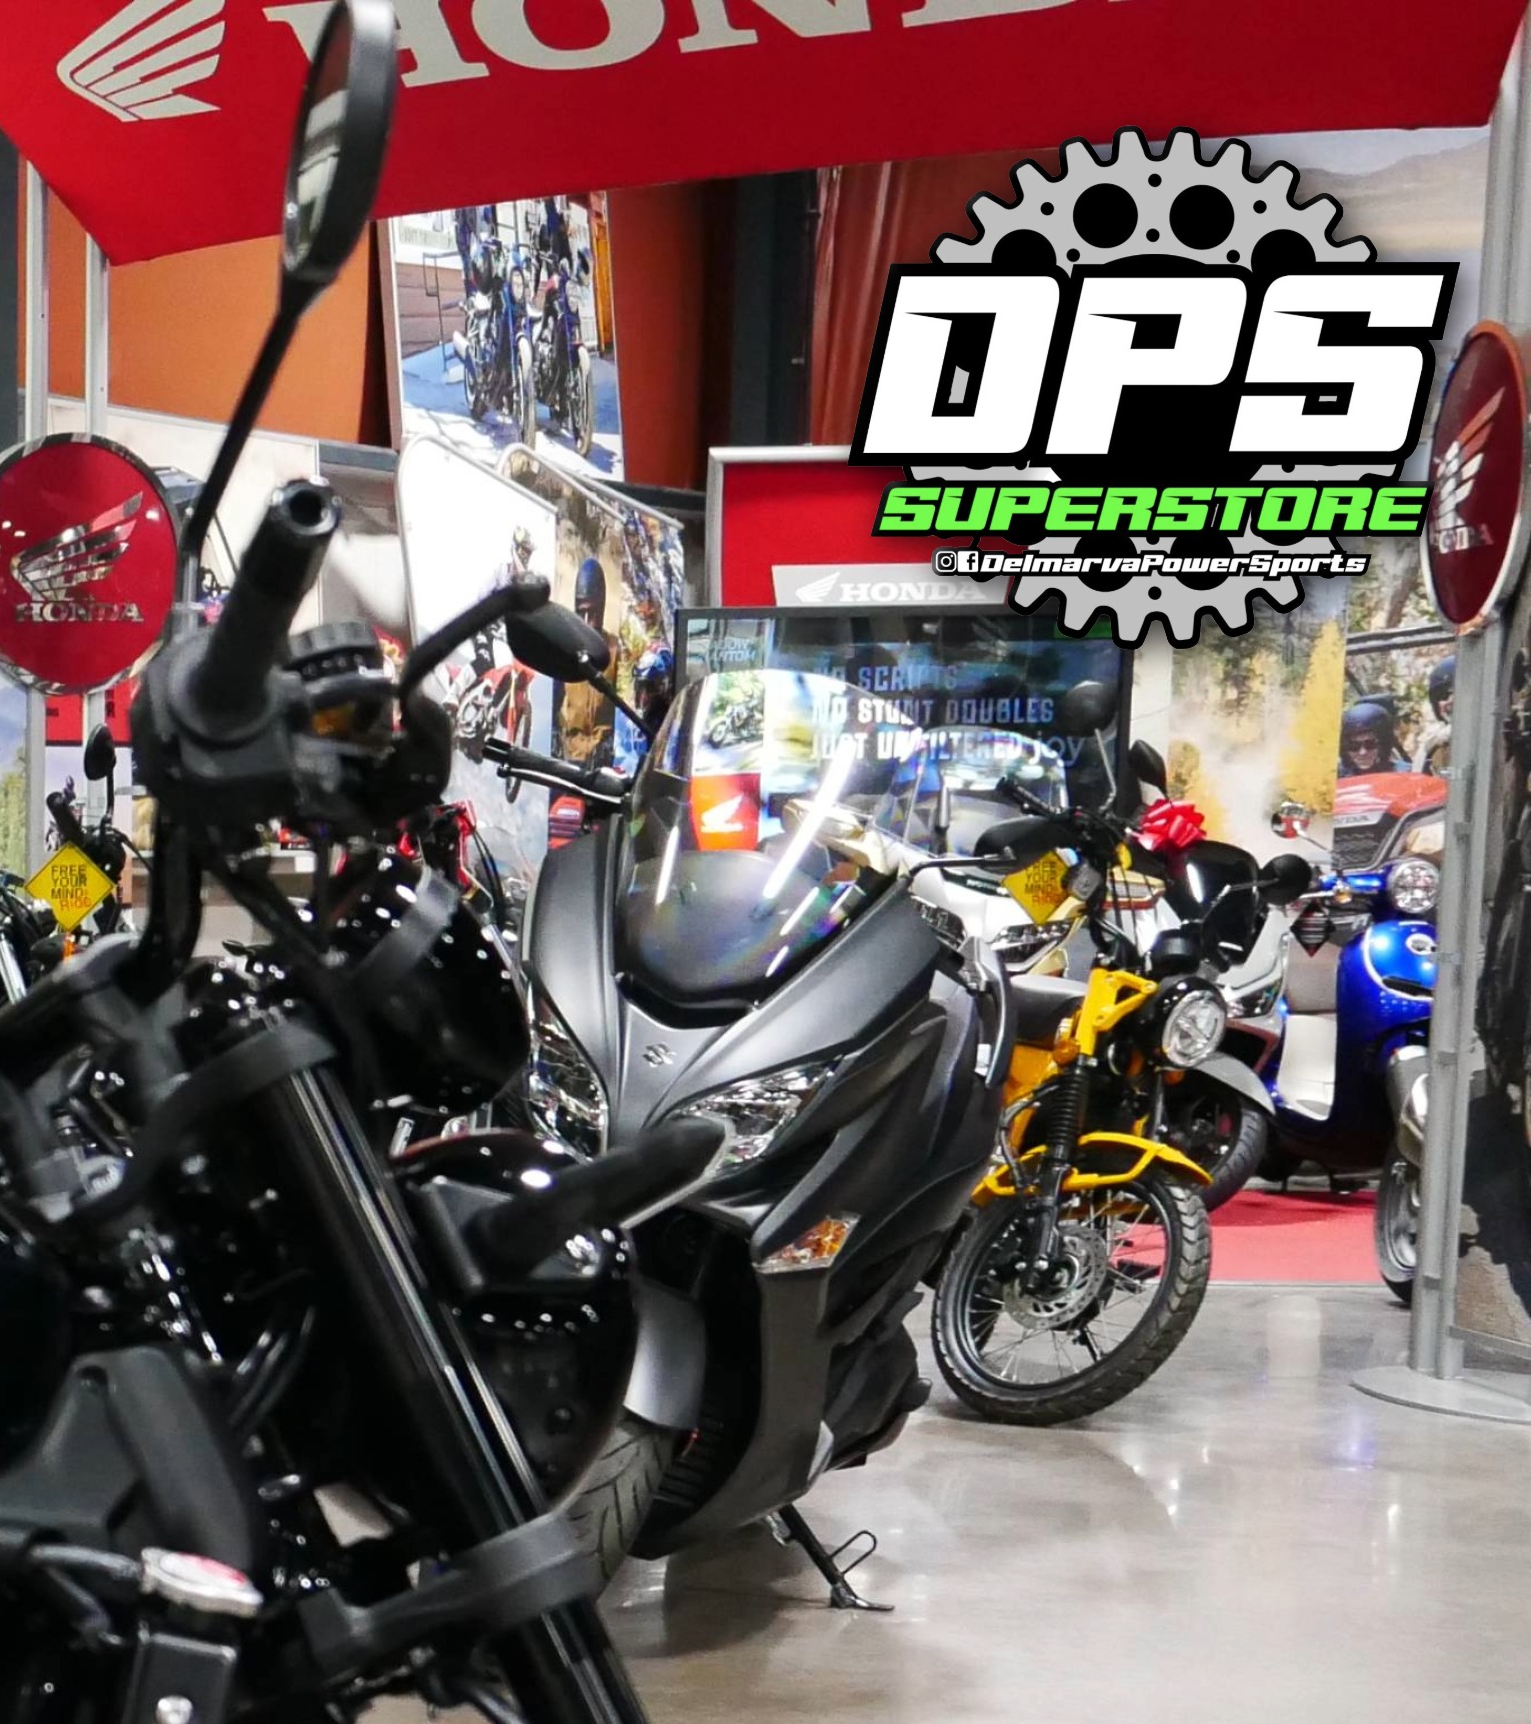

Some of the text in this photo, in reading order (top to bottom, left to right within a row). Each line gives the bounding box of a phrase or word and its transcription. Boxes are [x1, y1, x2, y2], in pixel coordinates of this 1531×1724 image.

[838, 581, 987, 603] HONDA
[14, 601, 145, 623] HONDA
[944, 698, 1055, 724] DOUBLES
[50, 864, 87, 877] FREE
[51, 876, 88, 889] YOUR
